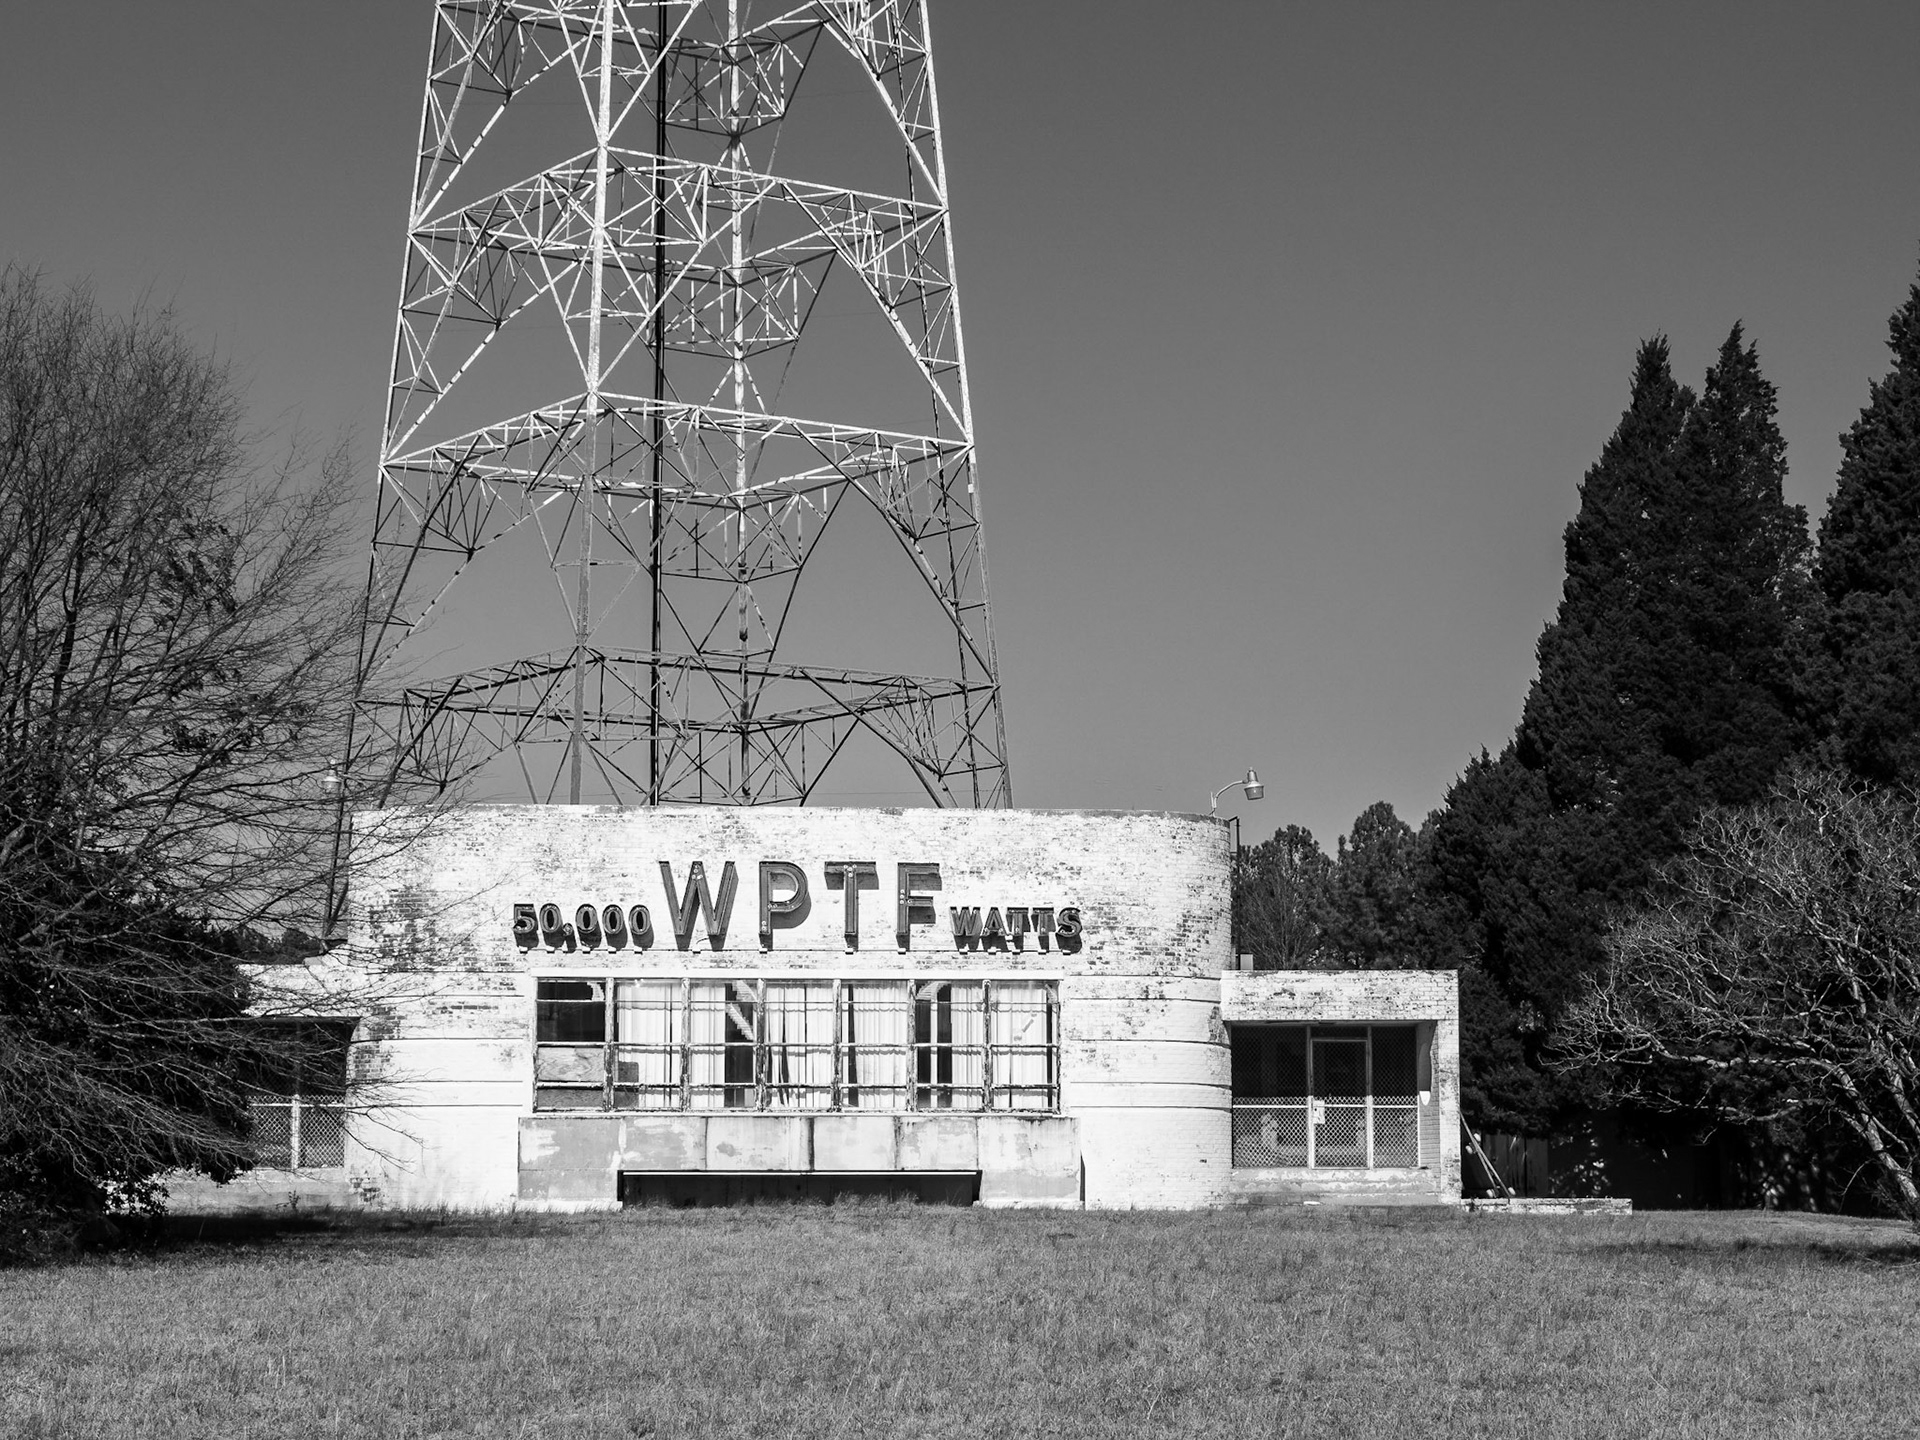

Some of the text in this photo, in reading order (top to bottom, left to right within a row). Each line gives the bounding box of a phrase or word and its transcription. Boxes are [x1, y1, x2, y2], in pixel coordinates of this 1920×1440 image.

[513, 861, 1082, 938] 50,000 WPTF WATTS
